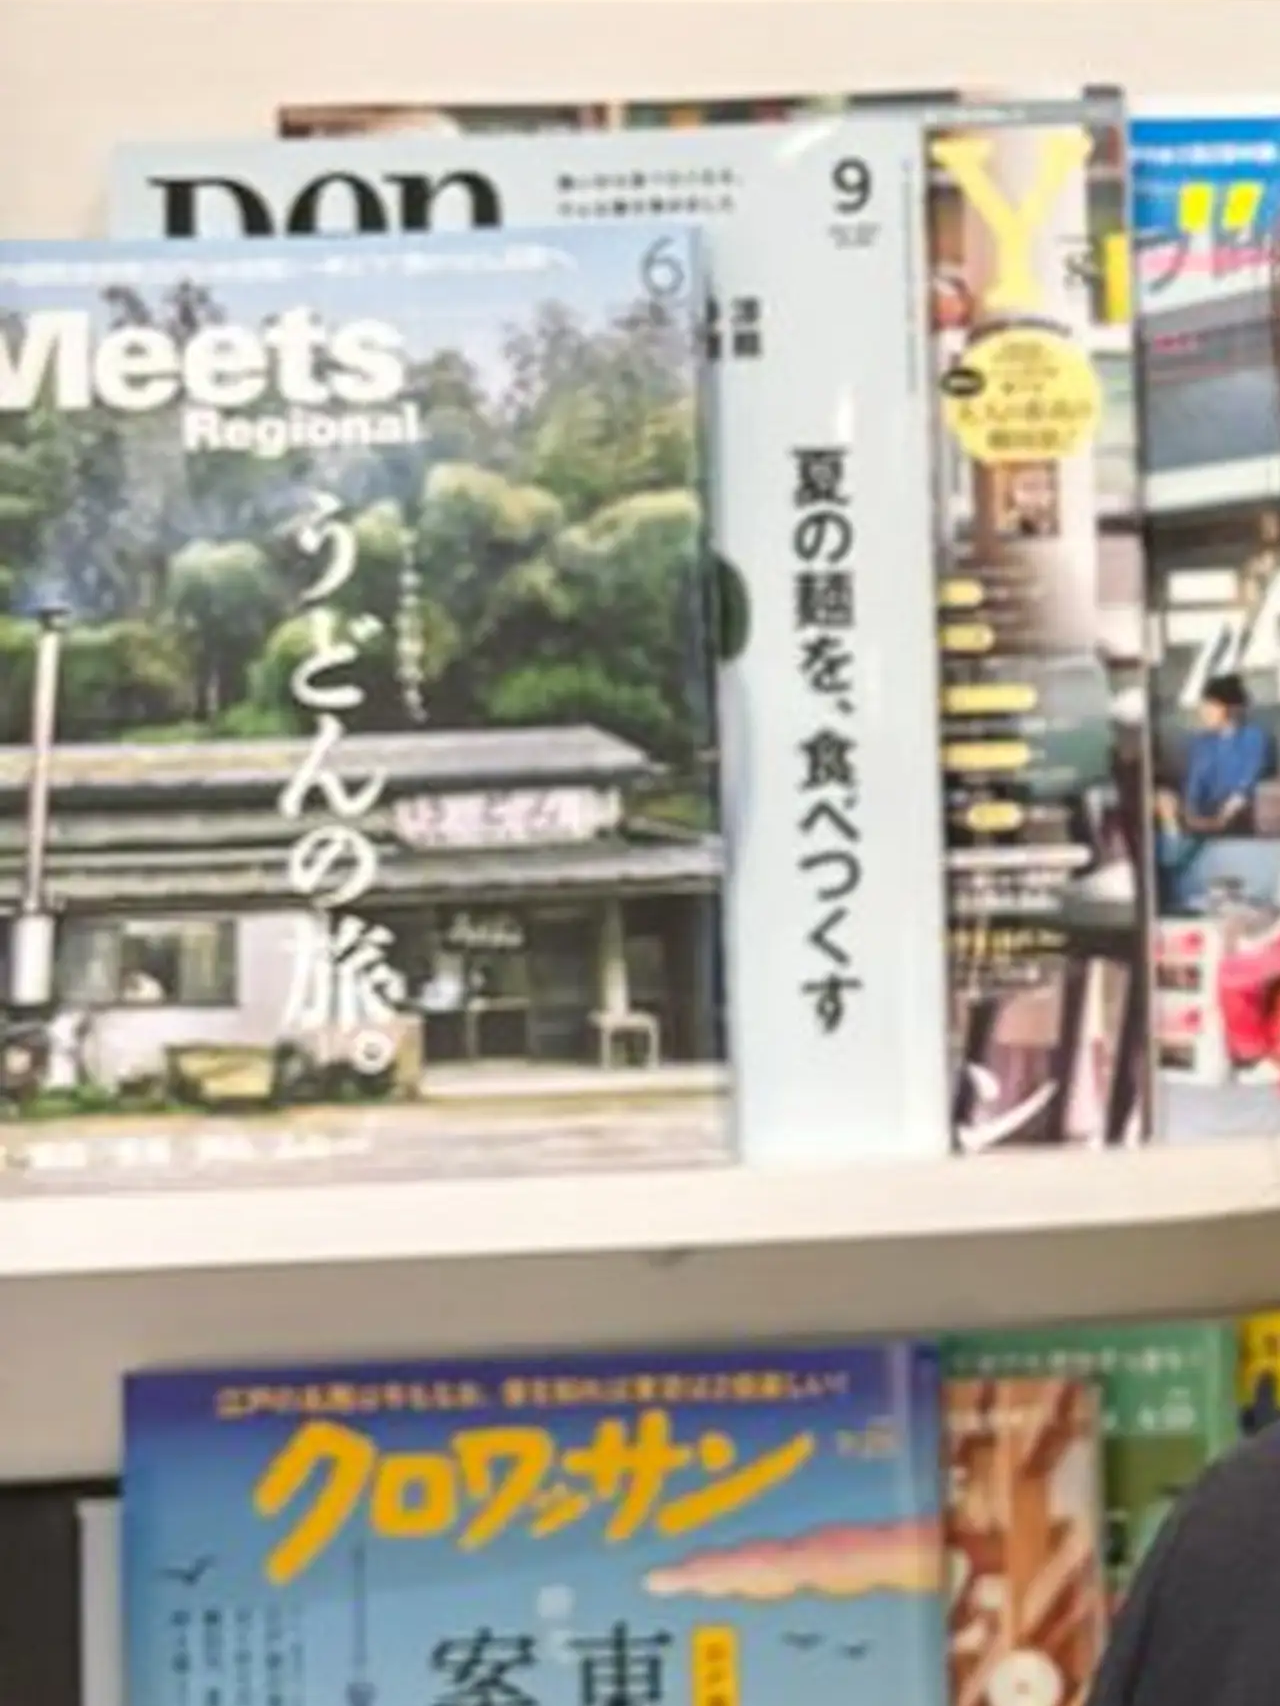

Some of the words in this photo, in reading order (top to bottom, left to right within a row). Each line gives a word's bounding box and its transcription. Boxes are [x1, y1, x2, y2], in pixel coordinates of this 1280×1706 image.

[831, 157, 872, 214] 9
[640, 235, 685, 297] 6
[0, 304, 406, 412] Meets
[183, 401, 420, 459] Regional
[275, 490, 408, 1075] うどんの旅。
[250, 1407, 817, 1586] クロワッサン
